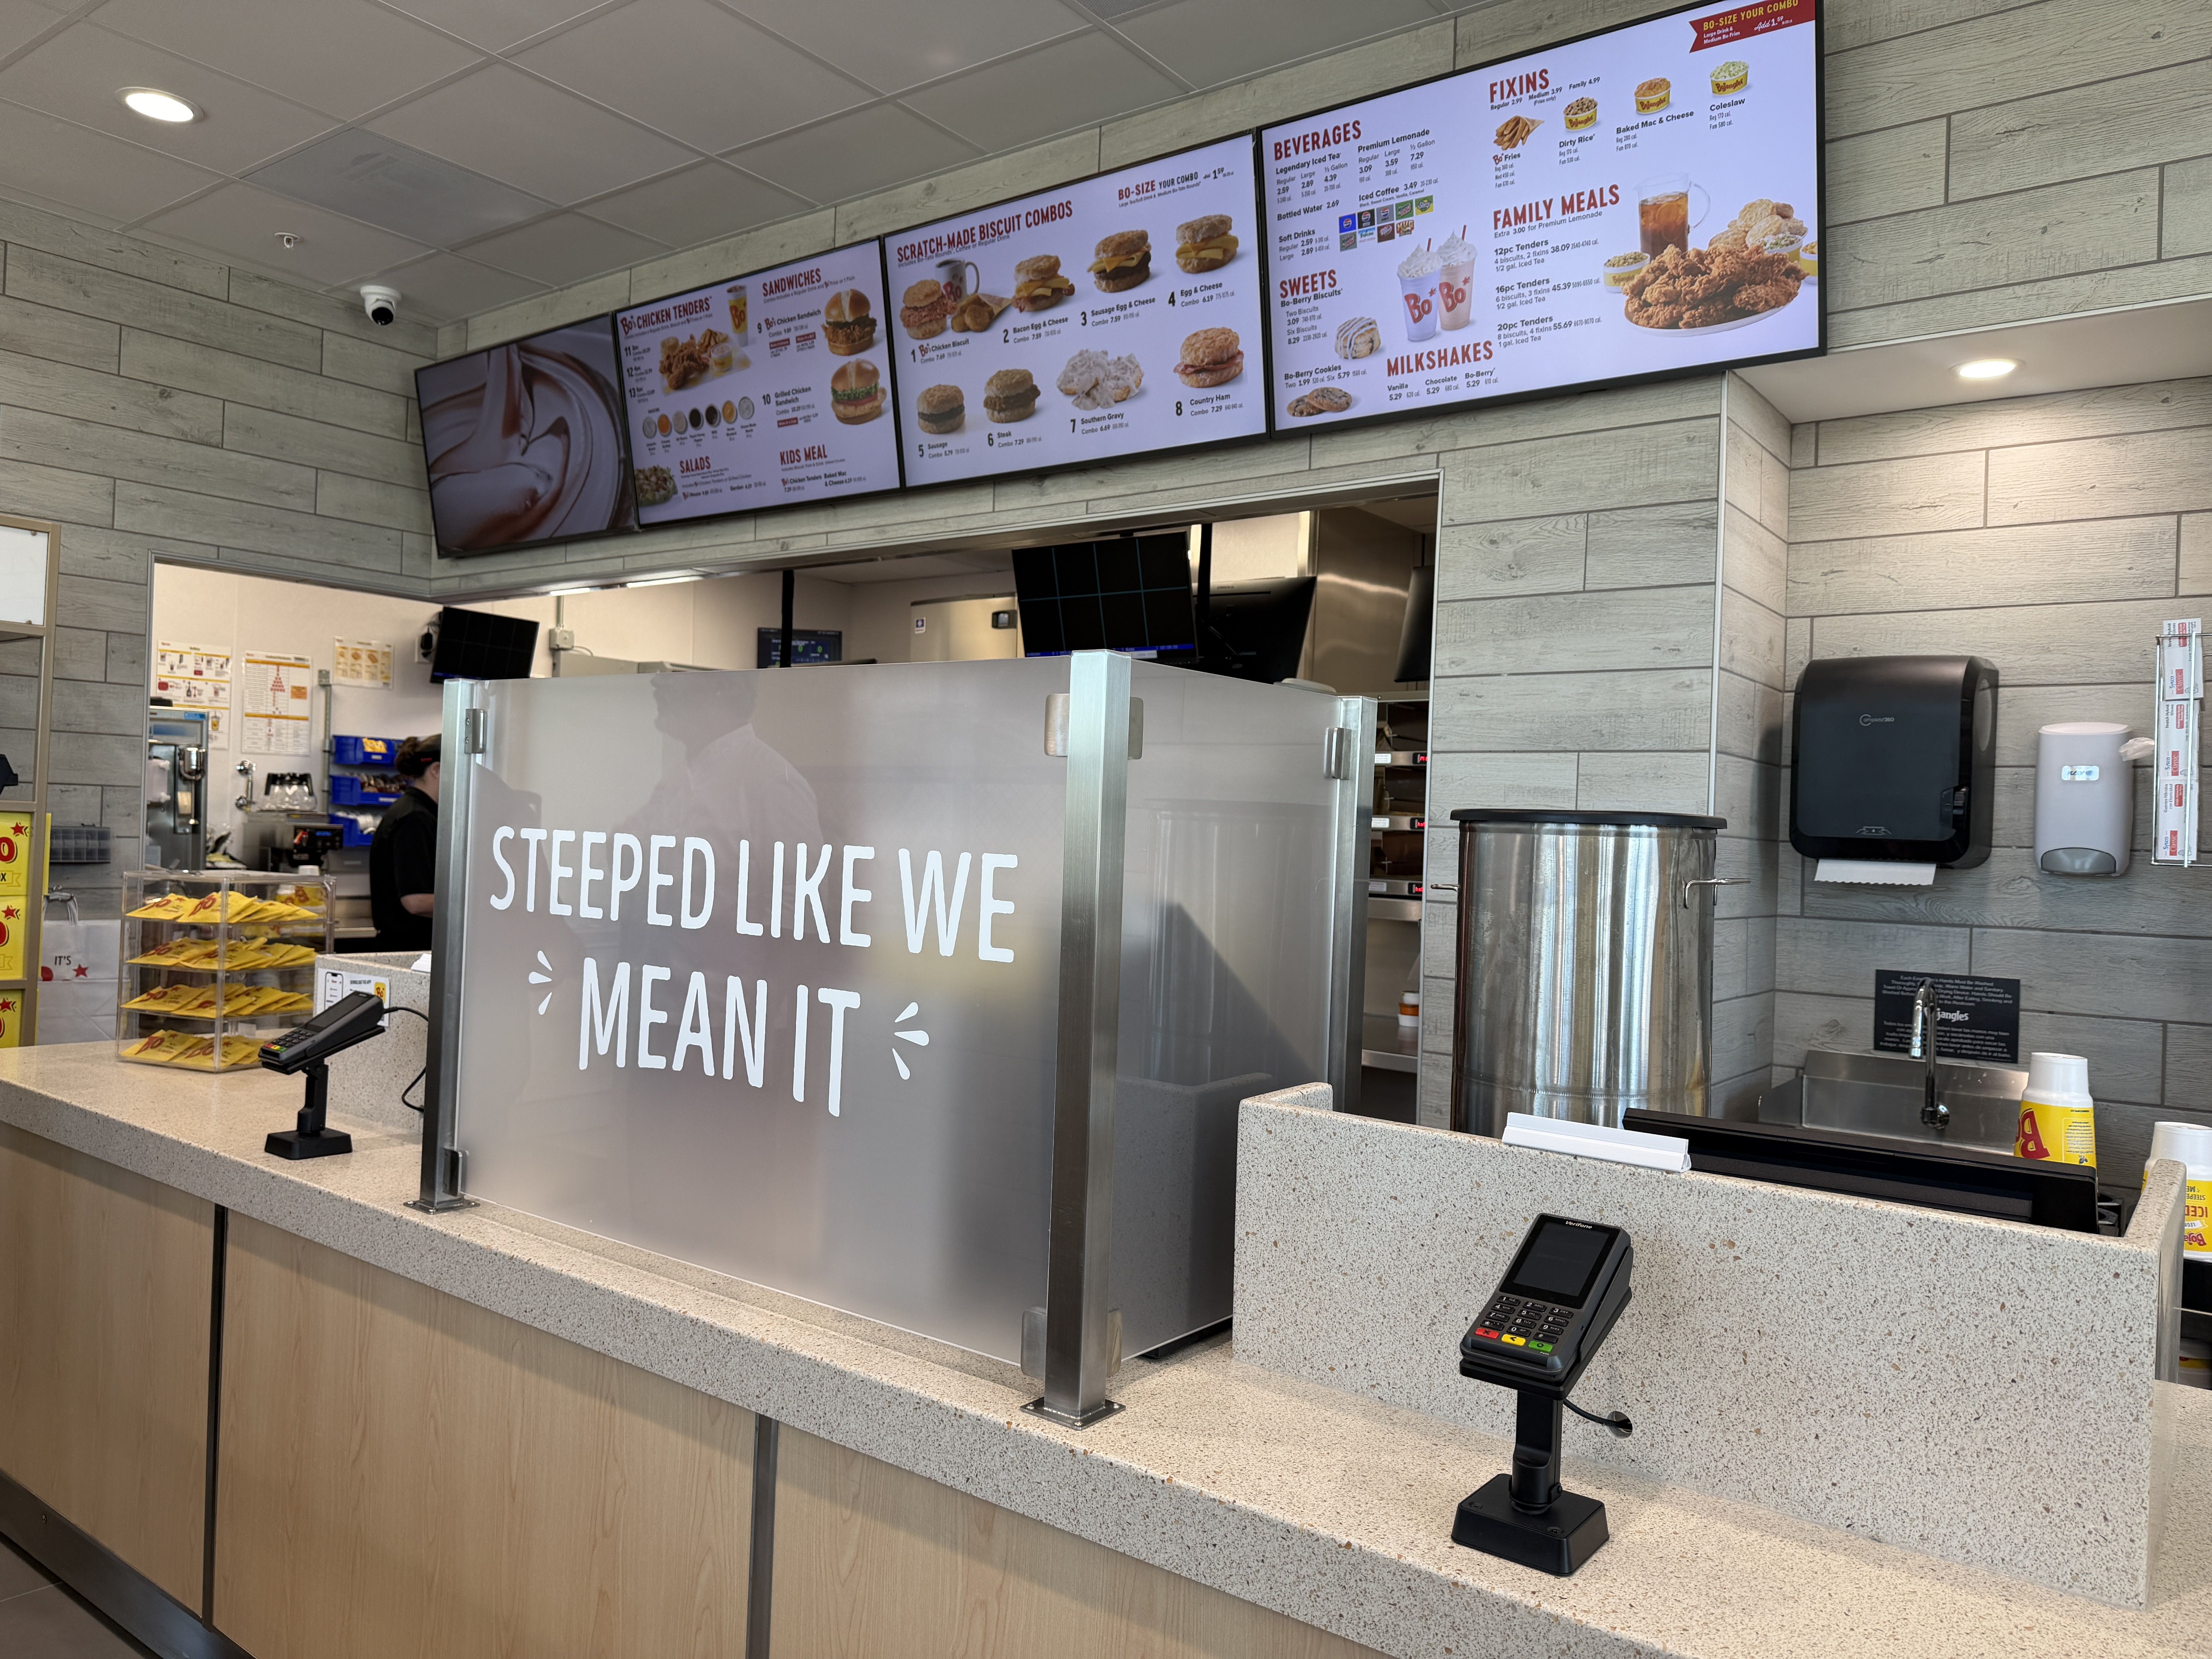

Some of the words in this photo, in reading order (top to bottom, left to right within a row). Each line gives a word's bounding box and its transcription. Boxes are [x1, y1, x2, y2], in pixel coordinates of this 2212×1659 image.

[1704, 14, 1737, 31] BO-SIZE
[1740, 7, 1764, 20] YOUR
[1767, 0, 1798, 13] COMBO
[1754, 20, 1771, 31] Add
[1490, 69, 1549, 103] FIXINS
[1569, 81, 1587, 89] Family
[1529, 91, 1549, 100] Medium
[1491, 101, 1509, 110] Regular
[1710, 98, 1745, 112] Coleslaw
[1616, 123, 1639, 134] Baked
[1641, 120, 1657, 128] Mac
[1666, 111, 1694, 122] Cheese
[1274, 120, 1362, 161] BEVERAGES
[1358, 139, 1390, 153] Premium
[1391, 129, 1430, 144] Lemonade
[1559, 139, 1576, 148] Dirty
[1578, 136, 1593, 144] Rice
[1358, 154, 1379, 163] Regular
[1384, 149, 1400, 157] Large
[1417, 139, 1435, 148] Gallon
[1504, 153, 1520, 161] Fries
[1276, 161, 1310, 174] Legendary
[1312, 156, 1326, 165] Iced
[1359, 165, 1372, 173] 3.09
[1385, 158, 1398, 167] 3.59
[1410, 151, 1424, 161] 7.29
[1276, 176, 1296, 185] Regular
[1331, 162, 1348, 171] Gallon
[1118, 180, 1156, 201] BO-SIZE
[1159, 178, 1175, 189] YOUR
[1176, 172, 1198, 185] COMBO
[1277, 186, 1289, 194] 2.59
[1302, 180, 1314, 189] 2.89
[1324, 174, 1337, 182] 4.39
[1359, 192, 1374, 201] Iced
[1376, 187, 1399, 196] Coffee
[1404, 181, 1417, 191] 3.49
[1277, 210, 1301, 221] Bottled
[1303, 204, 1323, 214] Water
[1327, 200, 1339, 208] 2.69
[1493, 198, 1553, 230] FAMILY
[1561, 184, 1620, 216] MEALS
[1397, 221, 1413, 231] MUG
[1538, 219, 1567, 229] Premium
[1568, 211, 1602, 223] Lemonade
[897, 226, 976, 263] SCRATCH-MADE
[979, 214, 1022, 241] BISCUIT
[1025, 200, 1073, 228] COMBOS
[1279, 234, 1292, 242] Soft
[1294, 229, 1316, 239] Drinks
[1279, 243, 1298, 252] Regular
[1301, 238, 1313, 247] 2.59
[1302, 247, 1313, 256] 2.89
[1494, 247, 1513, 256] 12pc
[1515, 239, 1549, 251] Tenders
[1500, 254, 1525, 264] biscuits,
[1532, 249, 1549, 257] fixins
[1551, 244, 1570, 253] 38.09
[763, 268, 821, 297] SANDWICHES
[1280, 270, 1337, 299] SWEETS
[1496, 285, 1515, 294] 16pc
[1516, 278, 1550, 290] Tenders
[1168, 291, 1176, 307] 4
[1180, 288, 1192, 297] Egg
[1199, 282, 1223, 292] Cheese
[1281, 295, 1312, 307] Bo-Berry
[1314, 289, 1341, 300] Biscuits
[1501, 292, 1527, 302] biscuits,
[1534, 287, 1550, 295] fixins
[1552, 282, 1571, 292] 45.39
[1080, 311, 1087, 326] 3
[1091, 306, 1115, 317] Sausage
[1116, 303, 1127, 312] Egg
[1134, 297, 1156, 306] Cheese
[1181, 298, 1199, 307] Combo
[1298, 306, 1319, 315] Biscuits
[637, 308, 671, 329] CHICKEN
[673, 297, 710, 320] TENDERS
[757, 323, 762, 333] 9
[777, 316, 796, 325] Chicken
[797, 309, 821, 320] Sandwich
[1003, 329, 1010, 343] 2
[1013, 325, 1030, 334] Bacon
[1031, 323, 1041, 331] Egg
[1048, 316, 1069, 326] Cheese
[1092, 319, 1108, 327] Combo
[1296, 325, 1317, 333] Biscuits
[1497, 322, 1518, 332] 20pc
[1520, 316, 1553, 328] Tenders
[1503, 330, 1528, 340] biscuits,
[1553, 321, 1573, 330] 55.69
[911, 349, 916, 362] 1
[931, 343, 951, 352] Chicken
[952, 338, 969, 347] Biscuit
[1387, 340, 1493, 376] MILKSHAKES
[1285, 370, 1313, 380] Bo-Berry
[1315, 365, 1341, 374] Cookies
[1425, 376, 1457, 386] Chocolate
[1465, 369, 1494, 379] Bo-Berry
[1388, 383, 1408, 391] Vanilla
[1467, 380, 1480, 388] 5.29
[763, 394, 771, 405] 10
[775, 390, 791, 398] Grilled
[792, 387, 811, 395] Chicken
[776, 397, 799, 406] Sandwich
[1176, 401, 1182, 416] 8
[1190, 397, 1214, 407] Country
[1216, 393, 1231, 402] Ham
[1190, 409, 1209, 417] Combo
[1070, 419, 1076, 433] 7
[1081, 416, 1106, 425] Southern
[1107, 412, 1124, 421] Gravy
[988, 433, 994, 447] 6
[780, 448, 801, 466] KIDS
[804, 444, 828, 462] MEAL
[918, 445, 924, 458] 5
[927, 441, 948, 450] Sausage
[680, 456, 711, 474] SALADS
[490, 826, 715, 929] STEEPED
[736, 838, 875, 948] LIKE
[898, 848, 1018, 963] WE
[54, 955, 71, 965] IT'S
[579, 957, 768, 1088] MEAN
[793, 984, 860, 1117] IT
[1565, 1221, 1592, 1230] Verifone
